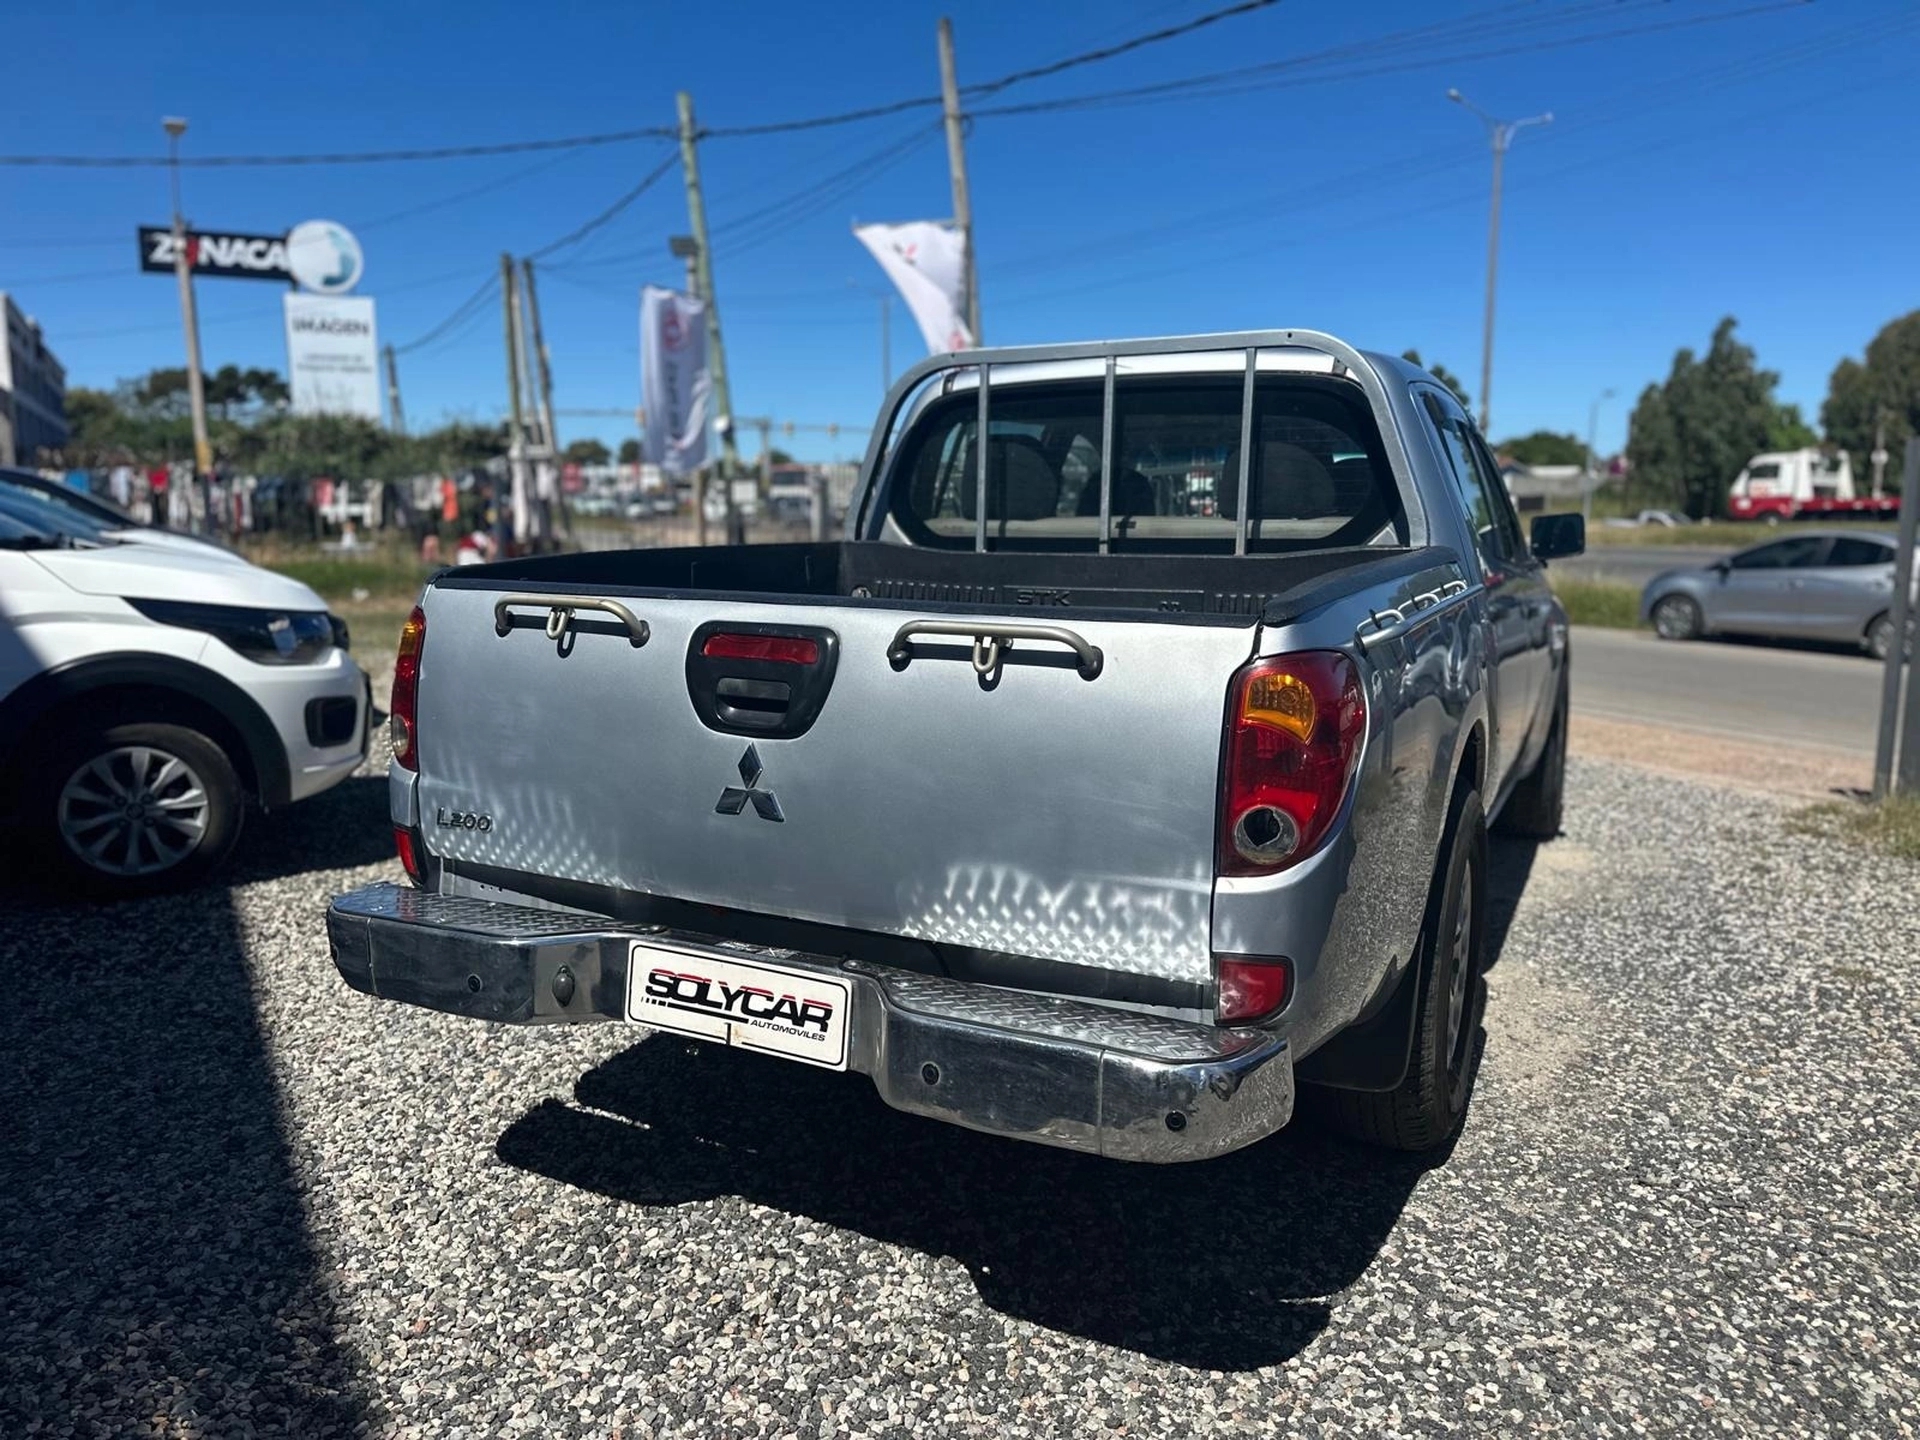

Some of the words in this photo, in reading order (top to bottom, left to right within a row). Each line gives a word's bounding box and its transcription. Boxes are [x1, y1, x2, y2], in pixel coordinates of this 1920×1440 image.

[1016, 589, 1071, 606] STK
[437, 806, 493, 834] L200
[645, 968, 833, 1032] SOLYCAR
[750, 1019, 826, 1042] AUTOMOVILES
